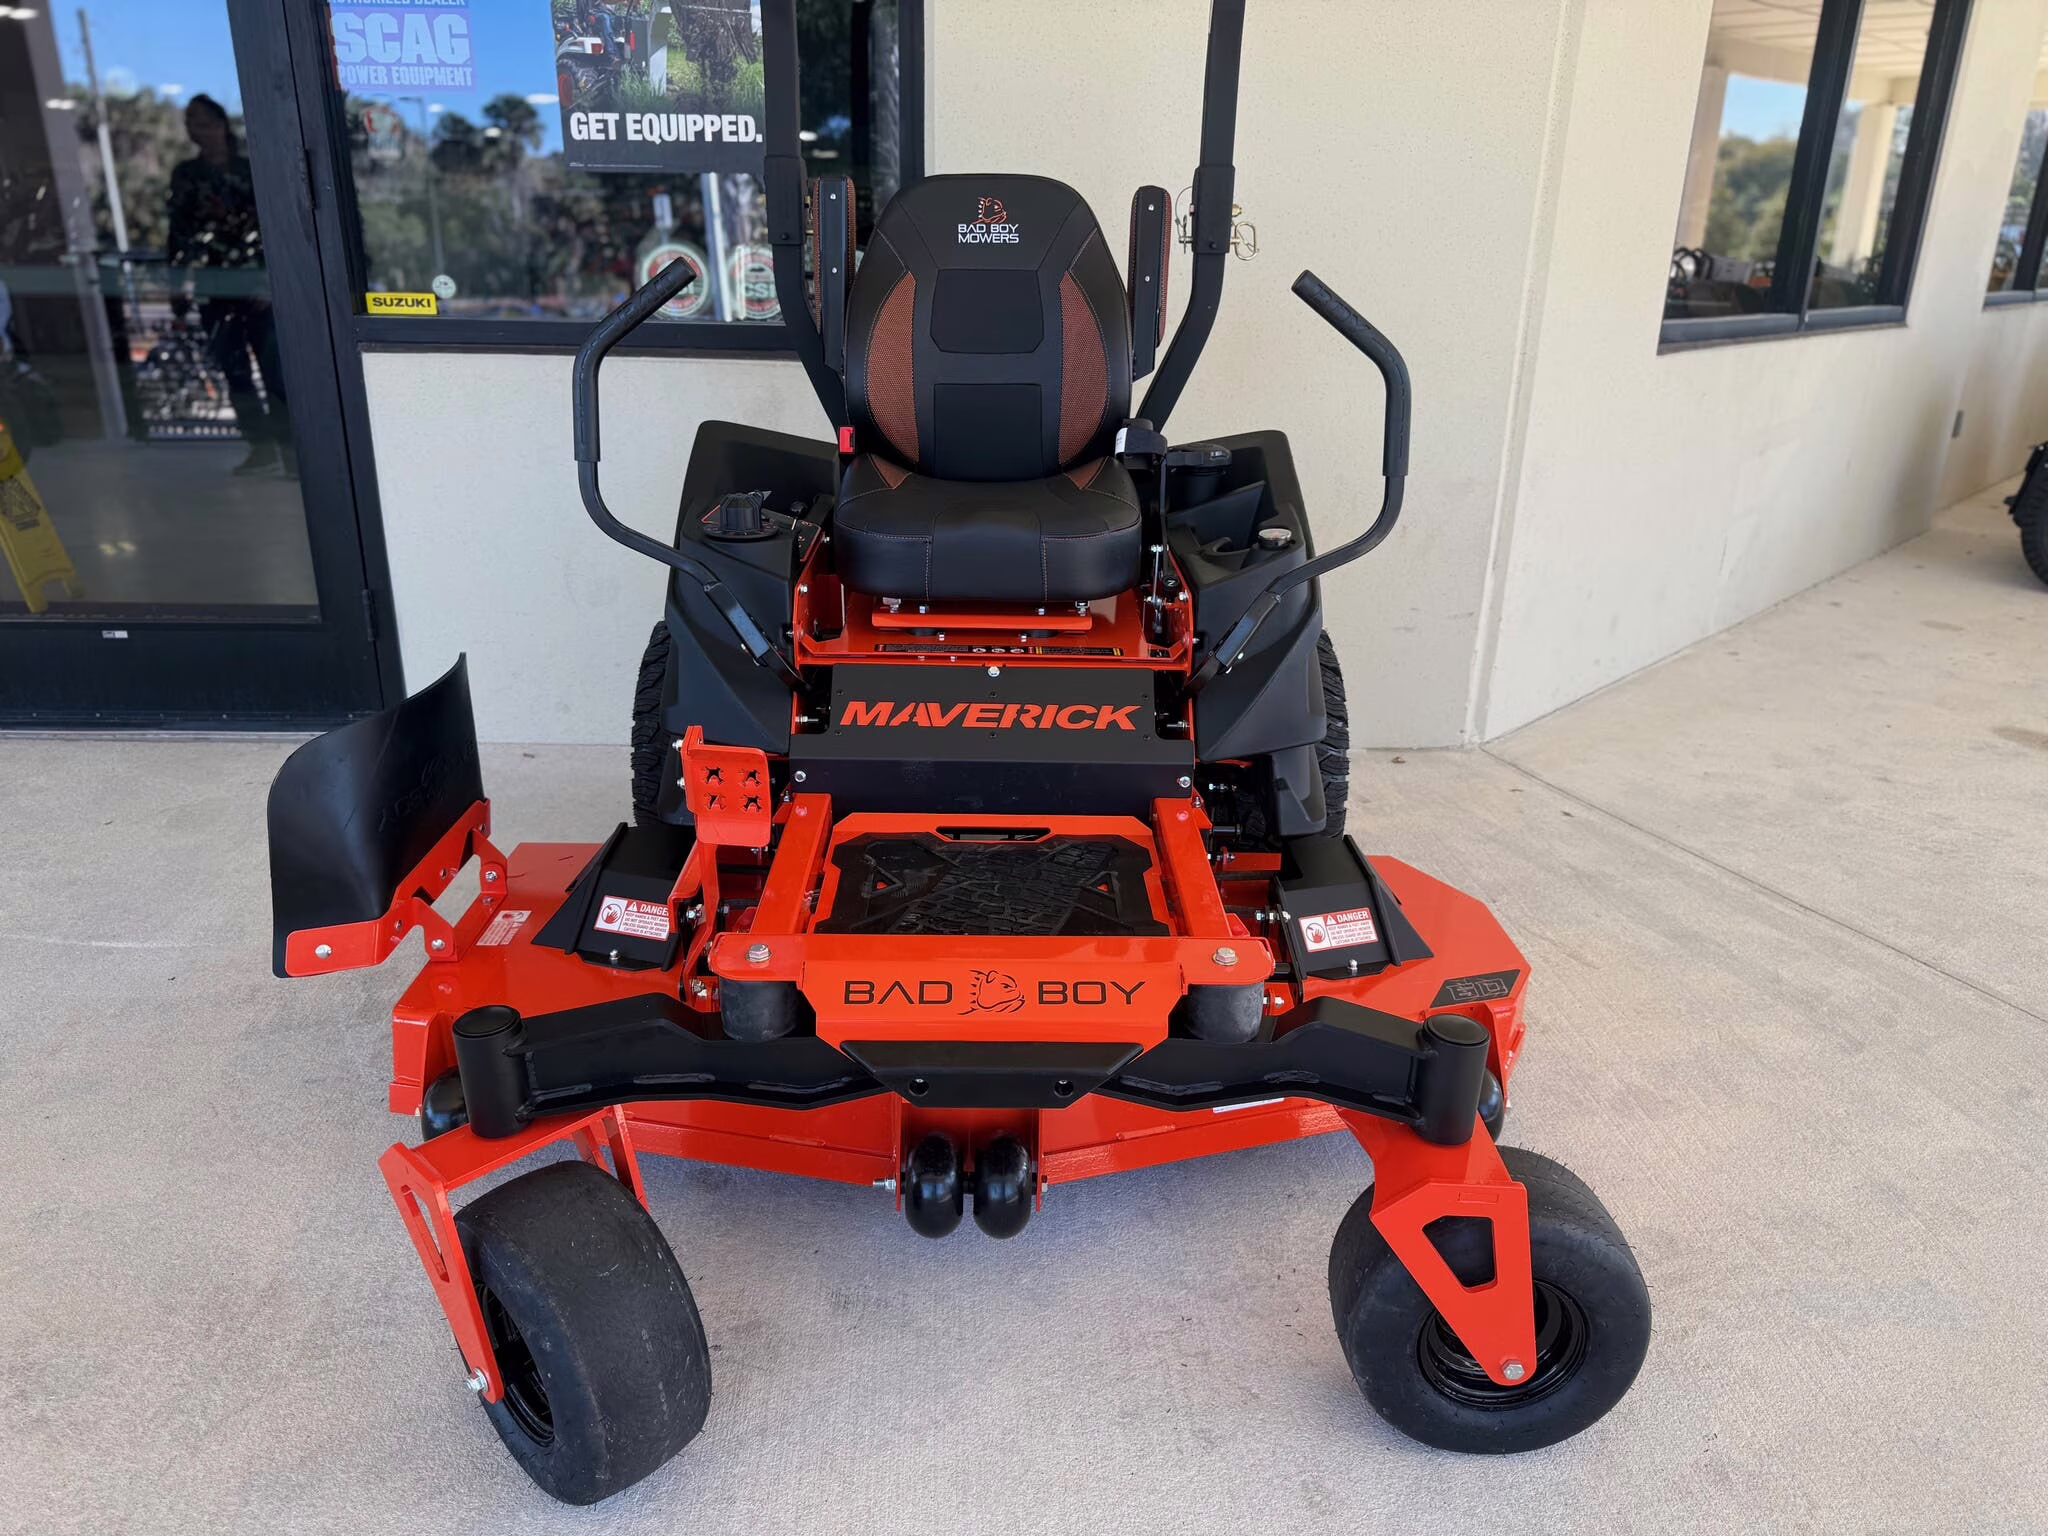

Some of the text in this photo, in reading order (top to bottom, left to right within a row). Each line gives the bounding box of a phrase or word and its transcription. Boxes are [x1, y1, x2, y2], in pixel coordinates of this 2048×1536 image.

[332, 12, 471, 64] SCAG
[337, 65, 472, 86] POWER EQUIPMENT
[570, 112, 763, 144] GET EQUIPPED.
[958, 224, 1019, 233] BAD BOY
[958, 233, 1019, 243] MOWERS
[372, 297, 431, 308] SUZUKI
[839, 701, 1145, 730] MAVERICK
[640, 904, 669, 916] DANGE
[1336, 910, 1369, 923] DANGER
[844, 980, 1146, 1005] BAD BOY
